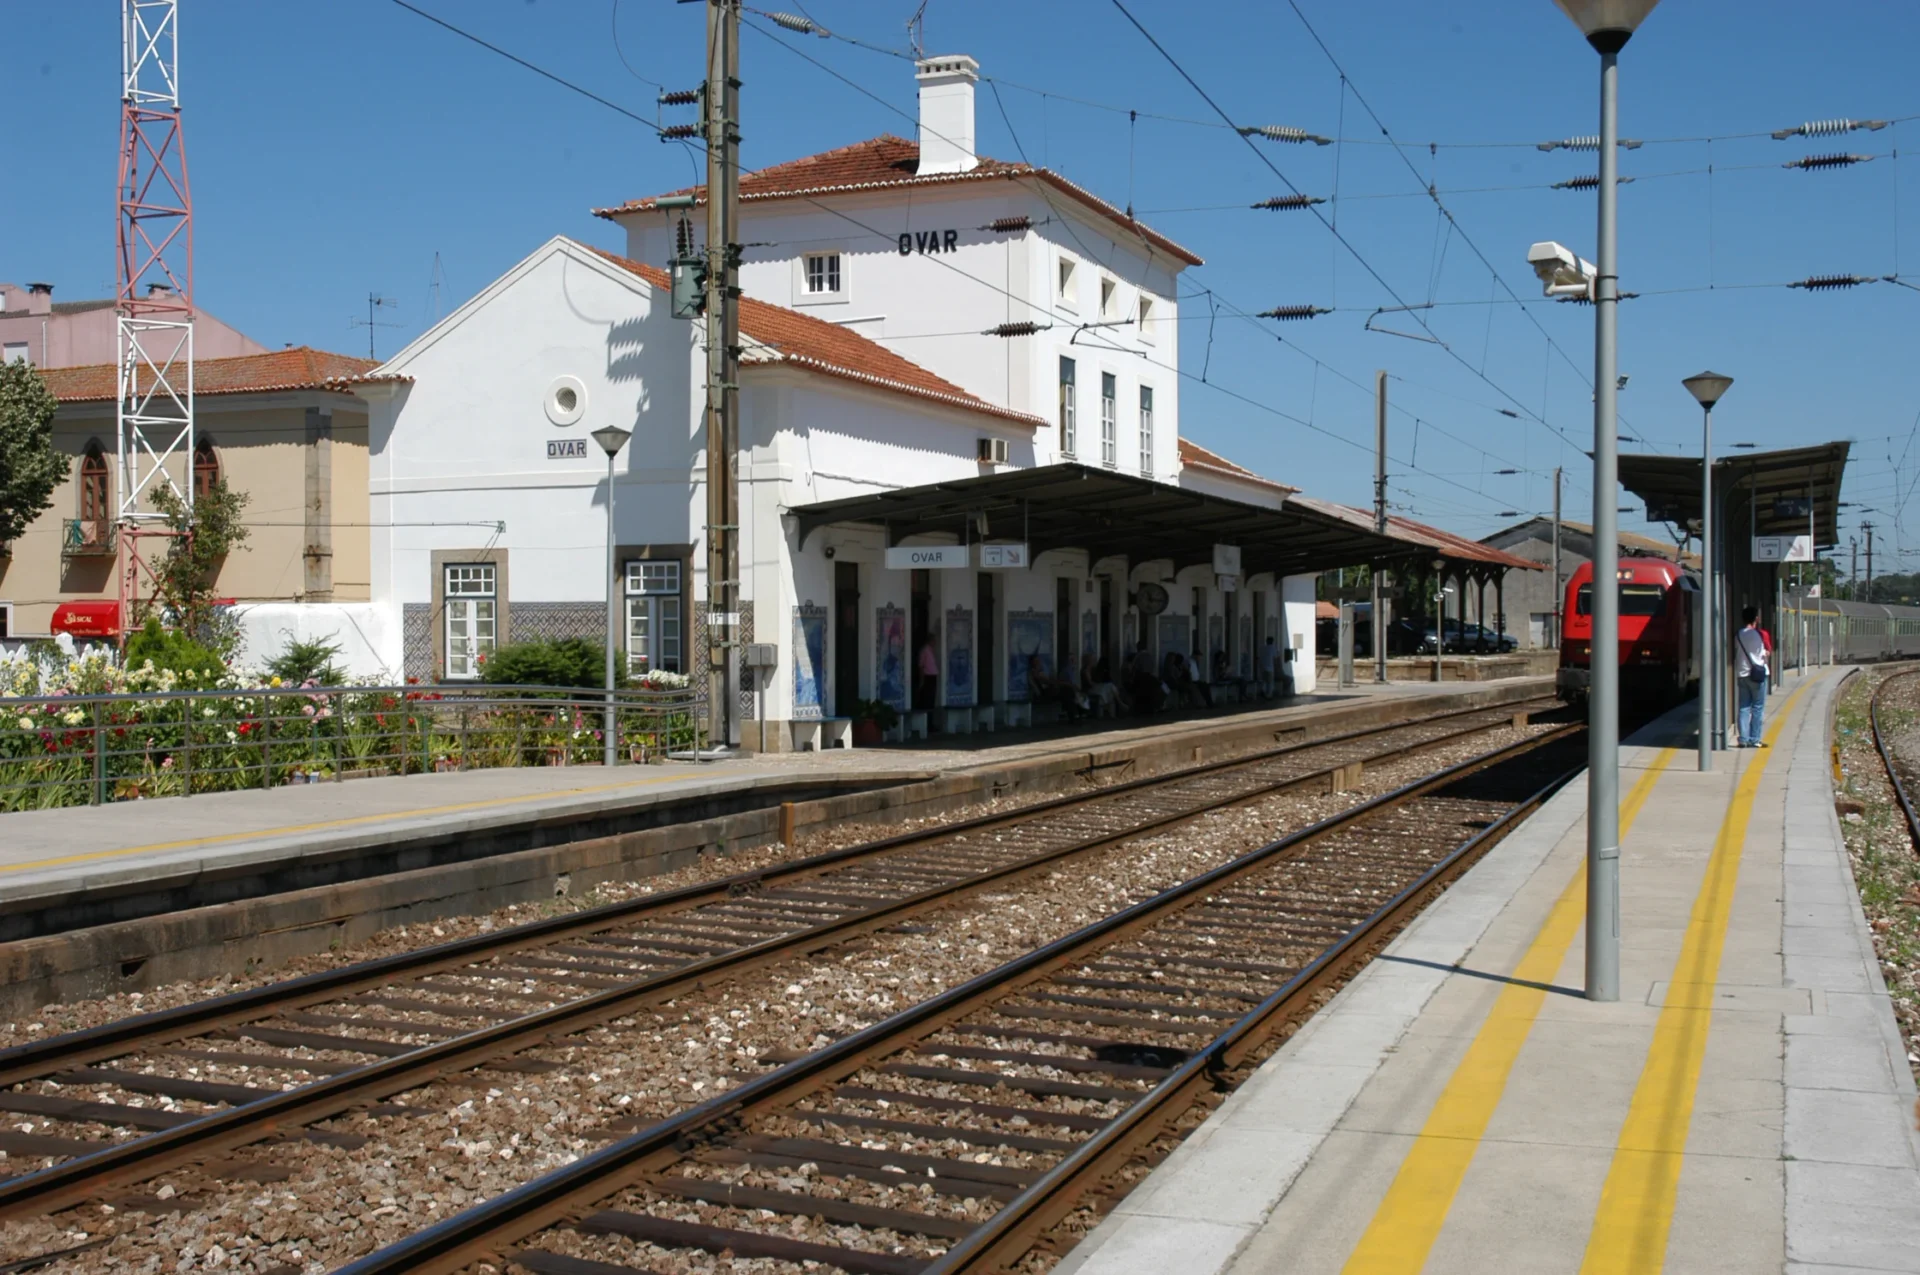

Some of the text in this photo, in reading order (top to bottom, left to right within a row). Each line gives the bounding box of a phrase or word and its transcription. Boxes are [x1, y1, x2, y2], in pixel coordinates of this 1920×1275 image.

[899, 229, 958, 256] OVAR
[548, 442, 585, 456] OVAR
[911, 552, 943, 563] OVAR
